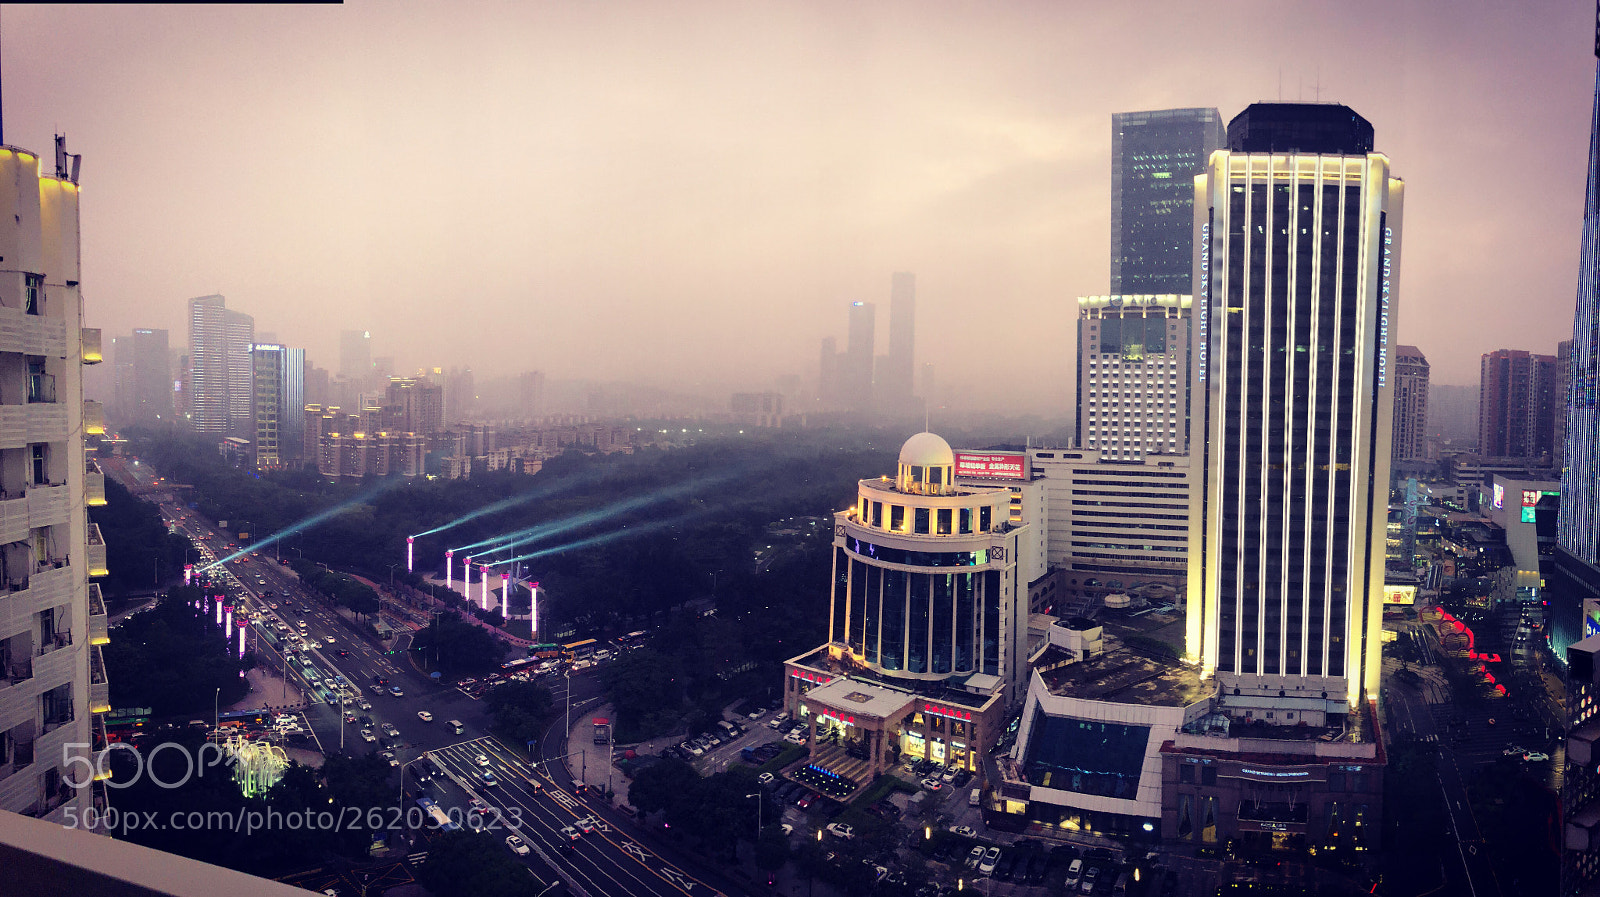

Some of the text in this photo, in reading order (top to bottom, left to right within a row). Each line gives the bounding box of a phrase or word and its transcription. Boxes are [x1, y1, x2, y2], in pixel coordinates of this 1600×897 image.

[1199, 222, 1210, 383] GRAND SKYLIGHT HOTEL
[1378, 226, 1392, 388] GRAND SKYLIGHT HOTEL
